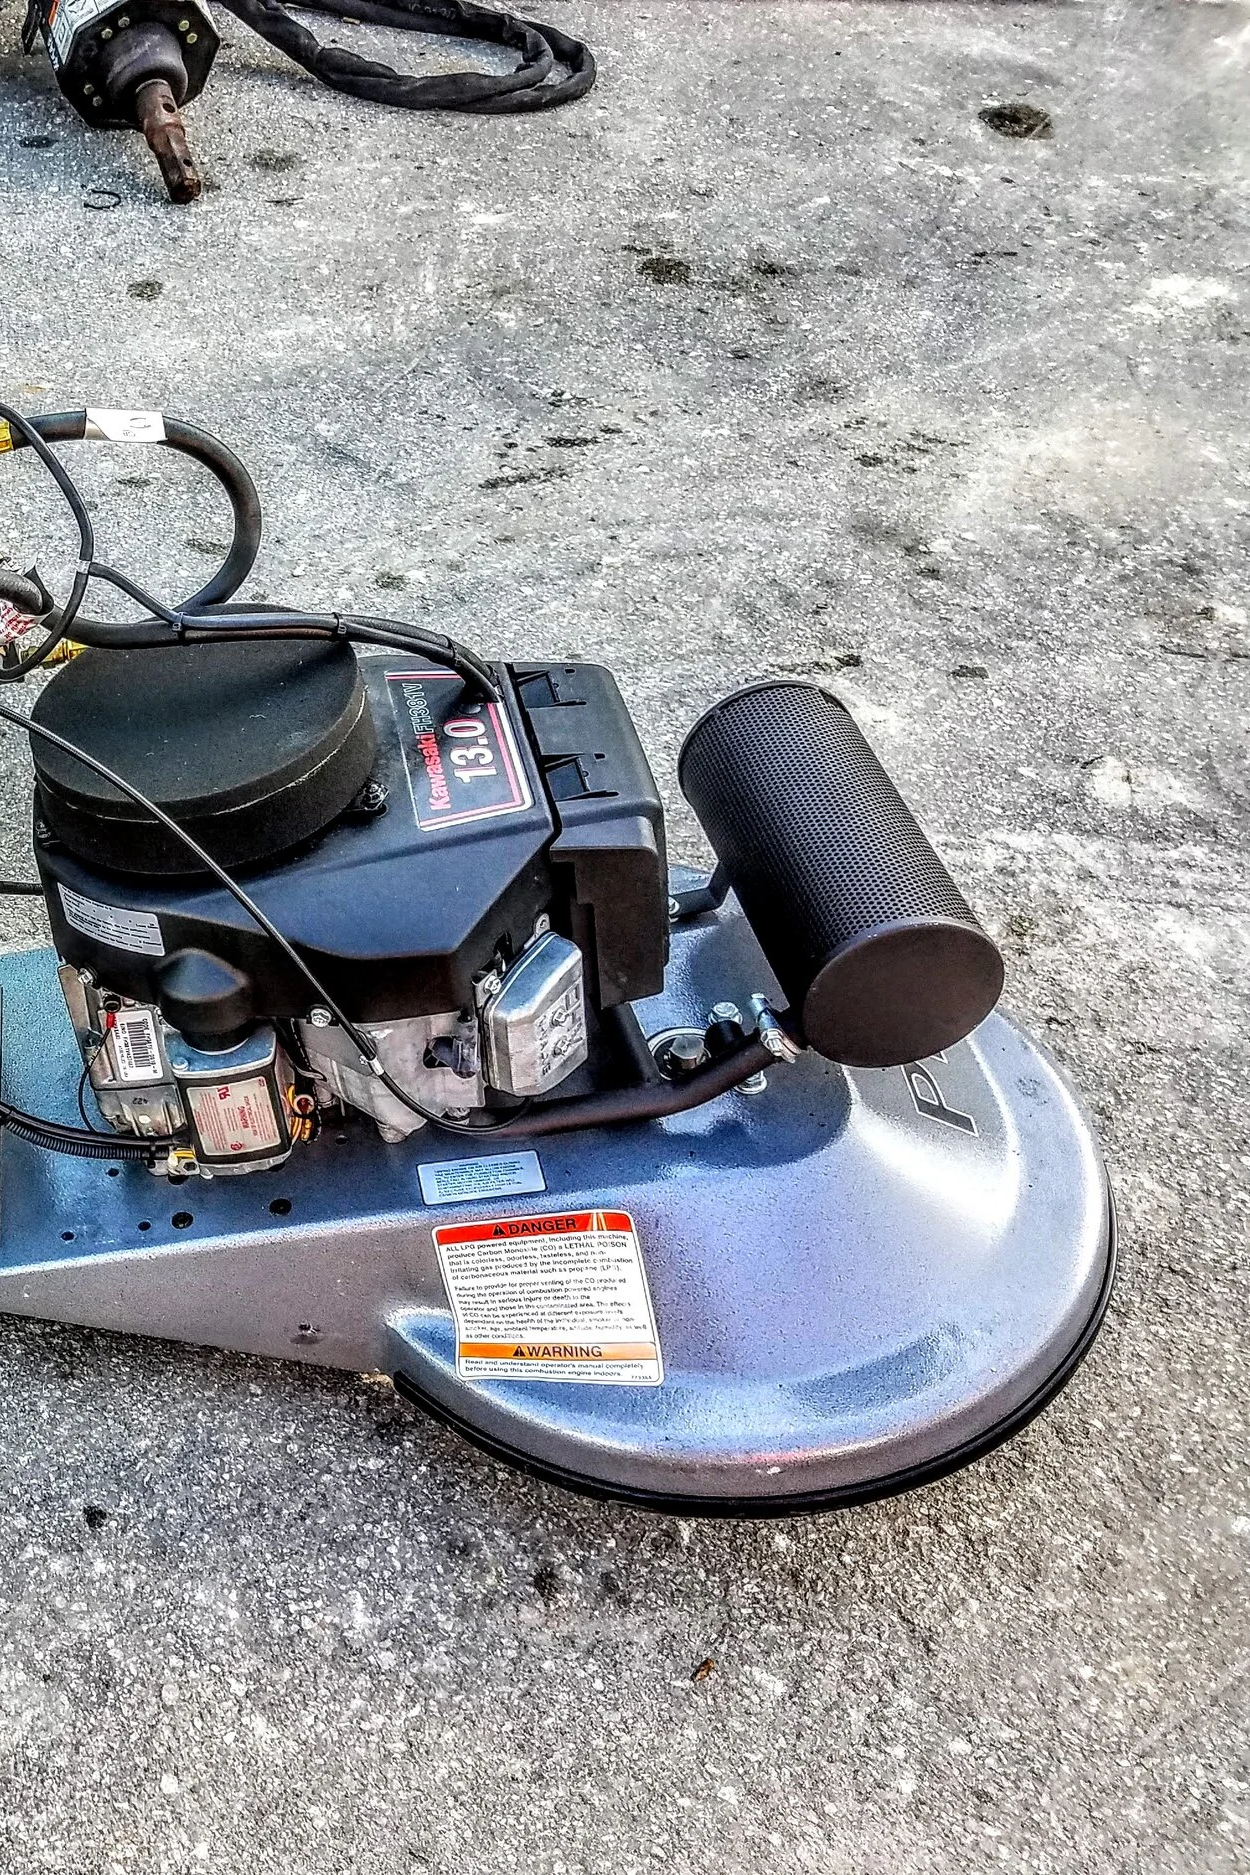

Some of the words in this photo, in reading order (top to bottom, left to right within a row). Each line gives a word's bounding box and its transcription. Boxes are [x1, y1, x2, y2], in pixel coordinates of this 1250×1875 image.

[402, 683, 435, 735] FH381V
[443, 717, 498, 784] 13.0
[415, 734, 451, 810] Kawasaki
[509, 1219, 576, 1234] DANGER
[477, 1241, 506, 1250] powered
[447, 1253, 475, 1261] produce
[526, 1345, 603, 1358] WARNING
